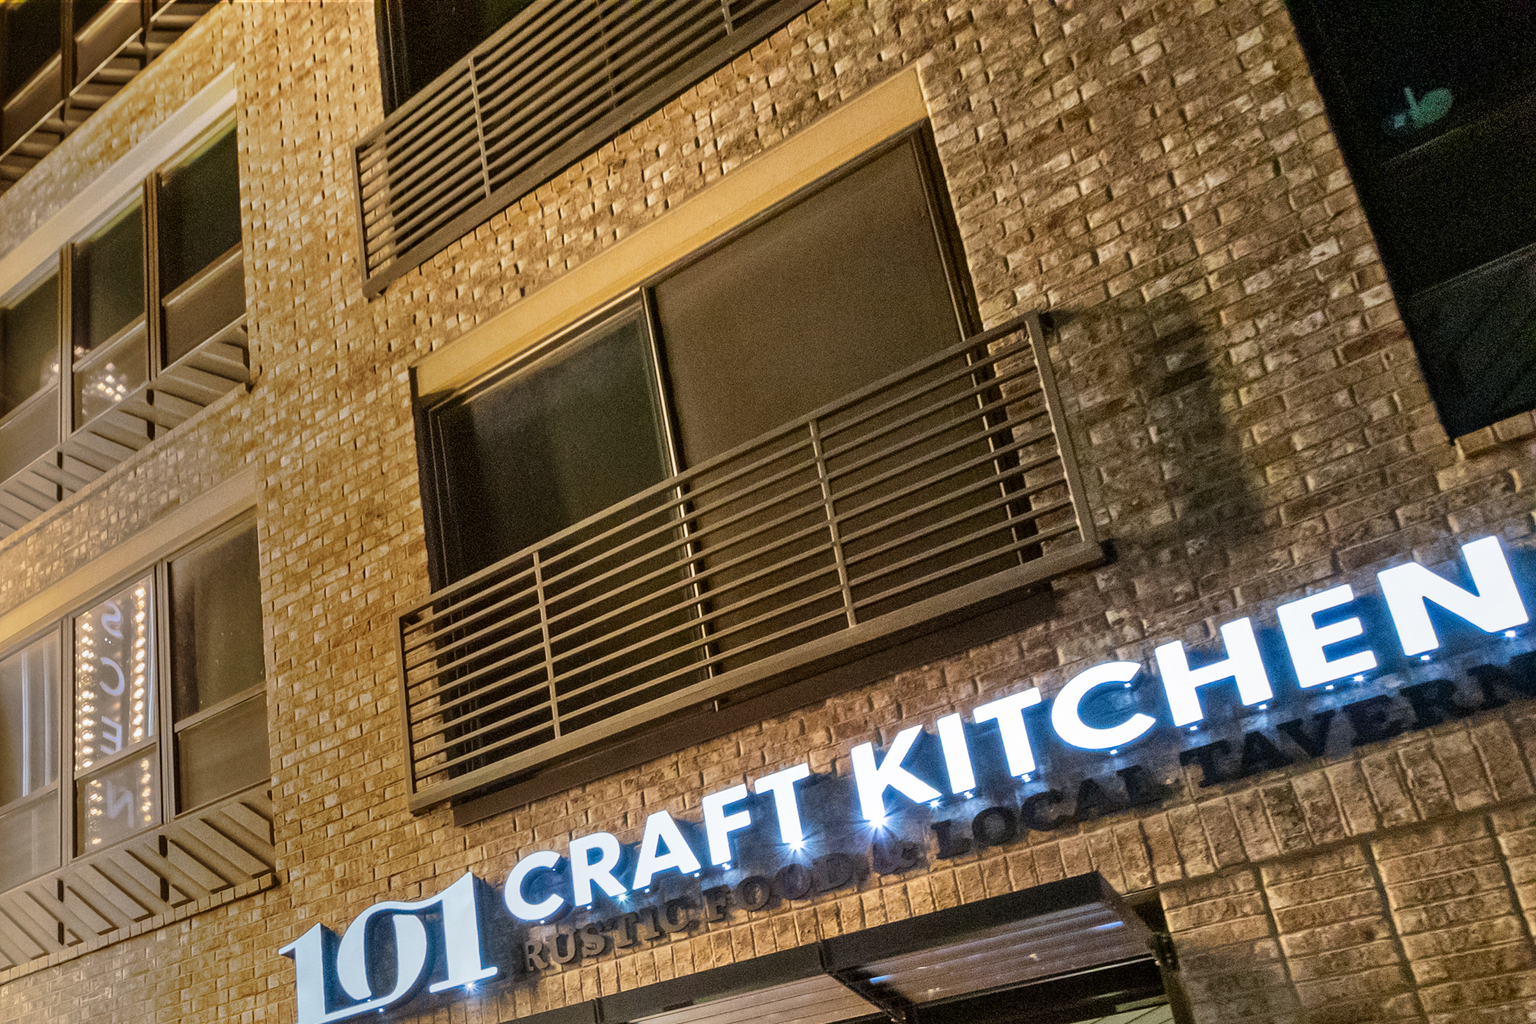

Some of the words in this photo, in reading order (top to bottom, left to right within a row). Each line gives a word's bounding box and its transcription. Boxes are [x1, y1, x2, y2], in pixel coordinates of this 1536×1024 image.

[503, 764, 809, 922] CRAFT
[849, 535, 1531, 822] KITCHEN
[522, 884, 693, 974] RUSTIC
[701, 850, 857, 924] FOOD
[930, 762, 1170, 861] LOCAL
[1178, 650, 1536, 789] TAVERN
